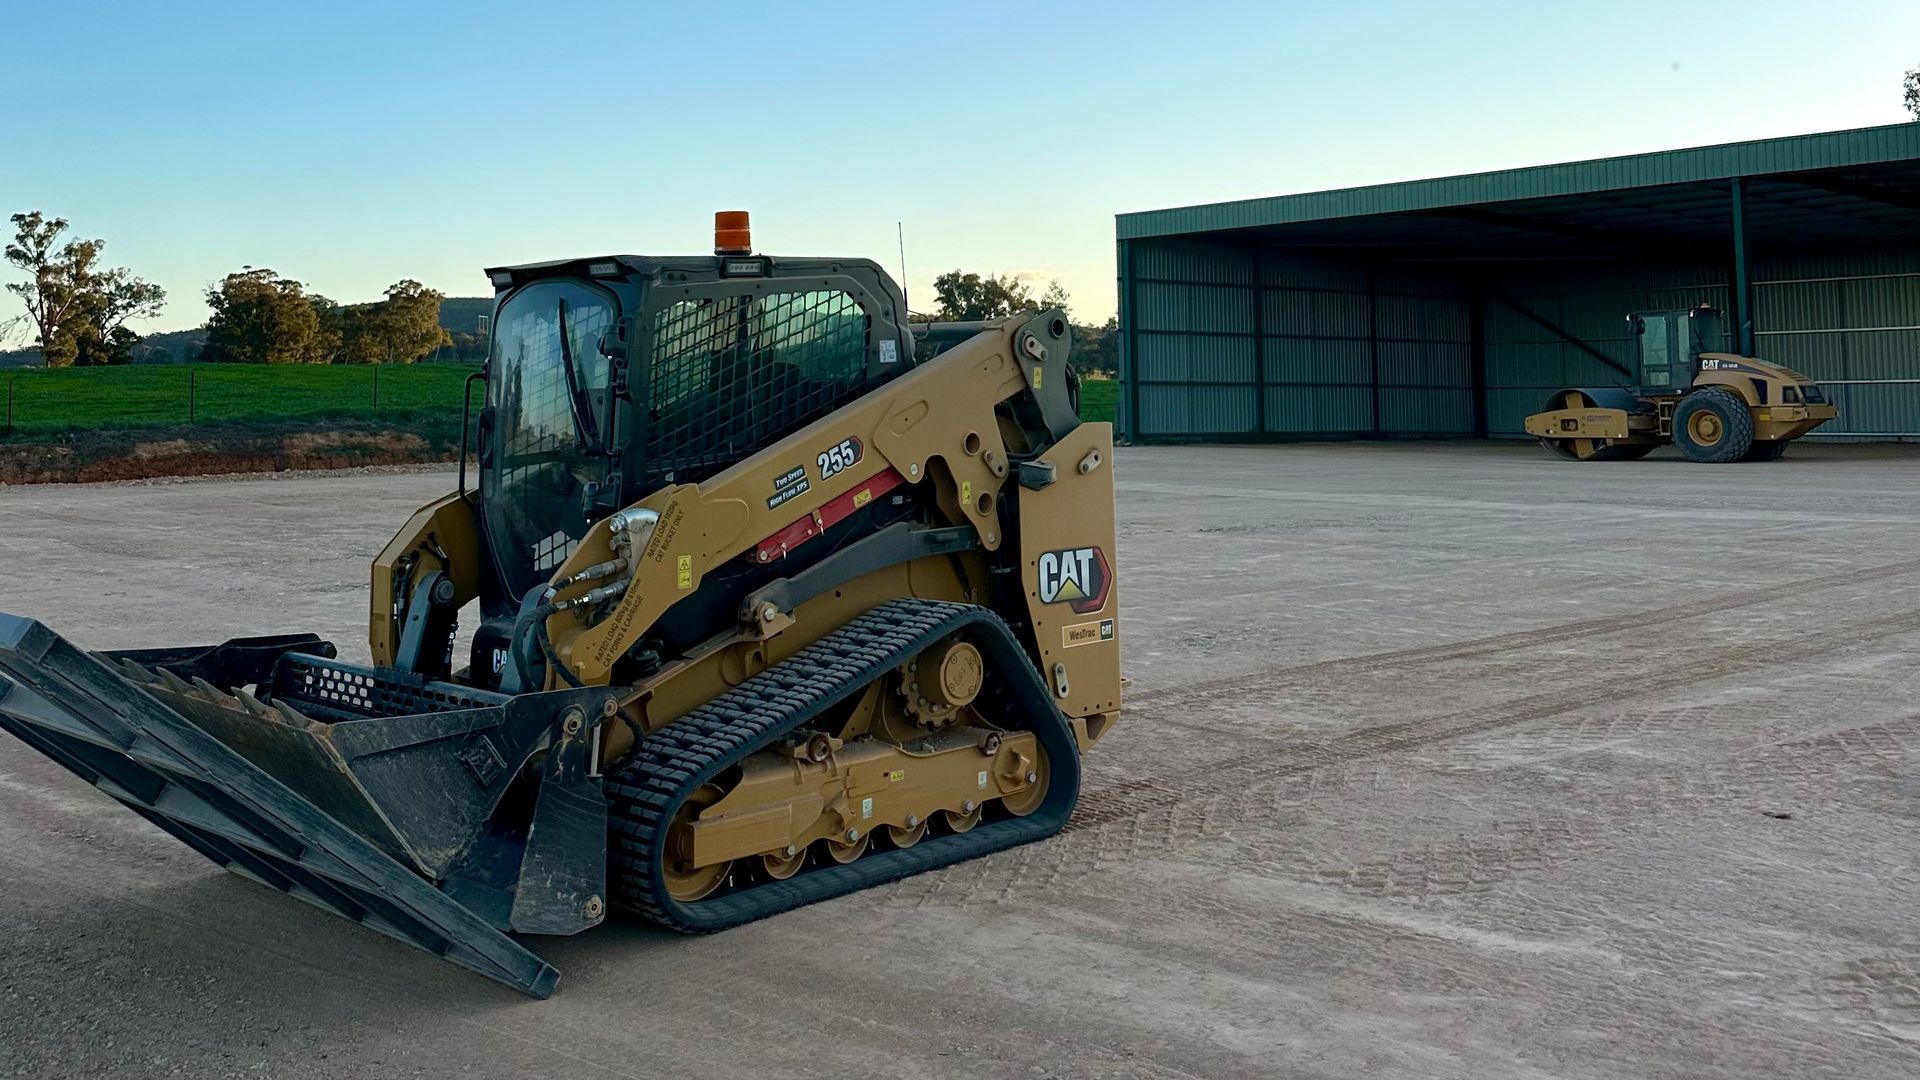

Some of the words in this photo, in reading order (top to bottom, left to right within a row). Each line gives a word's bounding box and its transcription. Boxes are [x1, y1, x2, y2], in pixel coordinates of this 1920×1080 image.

[1702, 359, 1719, 370] CAT
[817, 440, 855, 480] 255
[796, 480, 807, 492] XPS
[647, 537, 660, 558] RATED
[658, 519, 669, 538] LOAD
[655, 549, 665, 563] CAT
[661, 526, 677, 551] BUCKET
[673, 509, 684, 527] ONLY
[1039, 548, 1094, 603] CAT
[595, 640, 610, 663] RATED
[607, 622, 619, 641] LOAD
[602, 653, 613, 668] CAT
[611, 633, 625, 654] FORKS
[624, 594, 644, 628] CARRIAGE
[1069, 628, 1096, 641] WesTrac
[1101, 624, 1112, 636] CAT
[493, 649, 508, 674] CA
